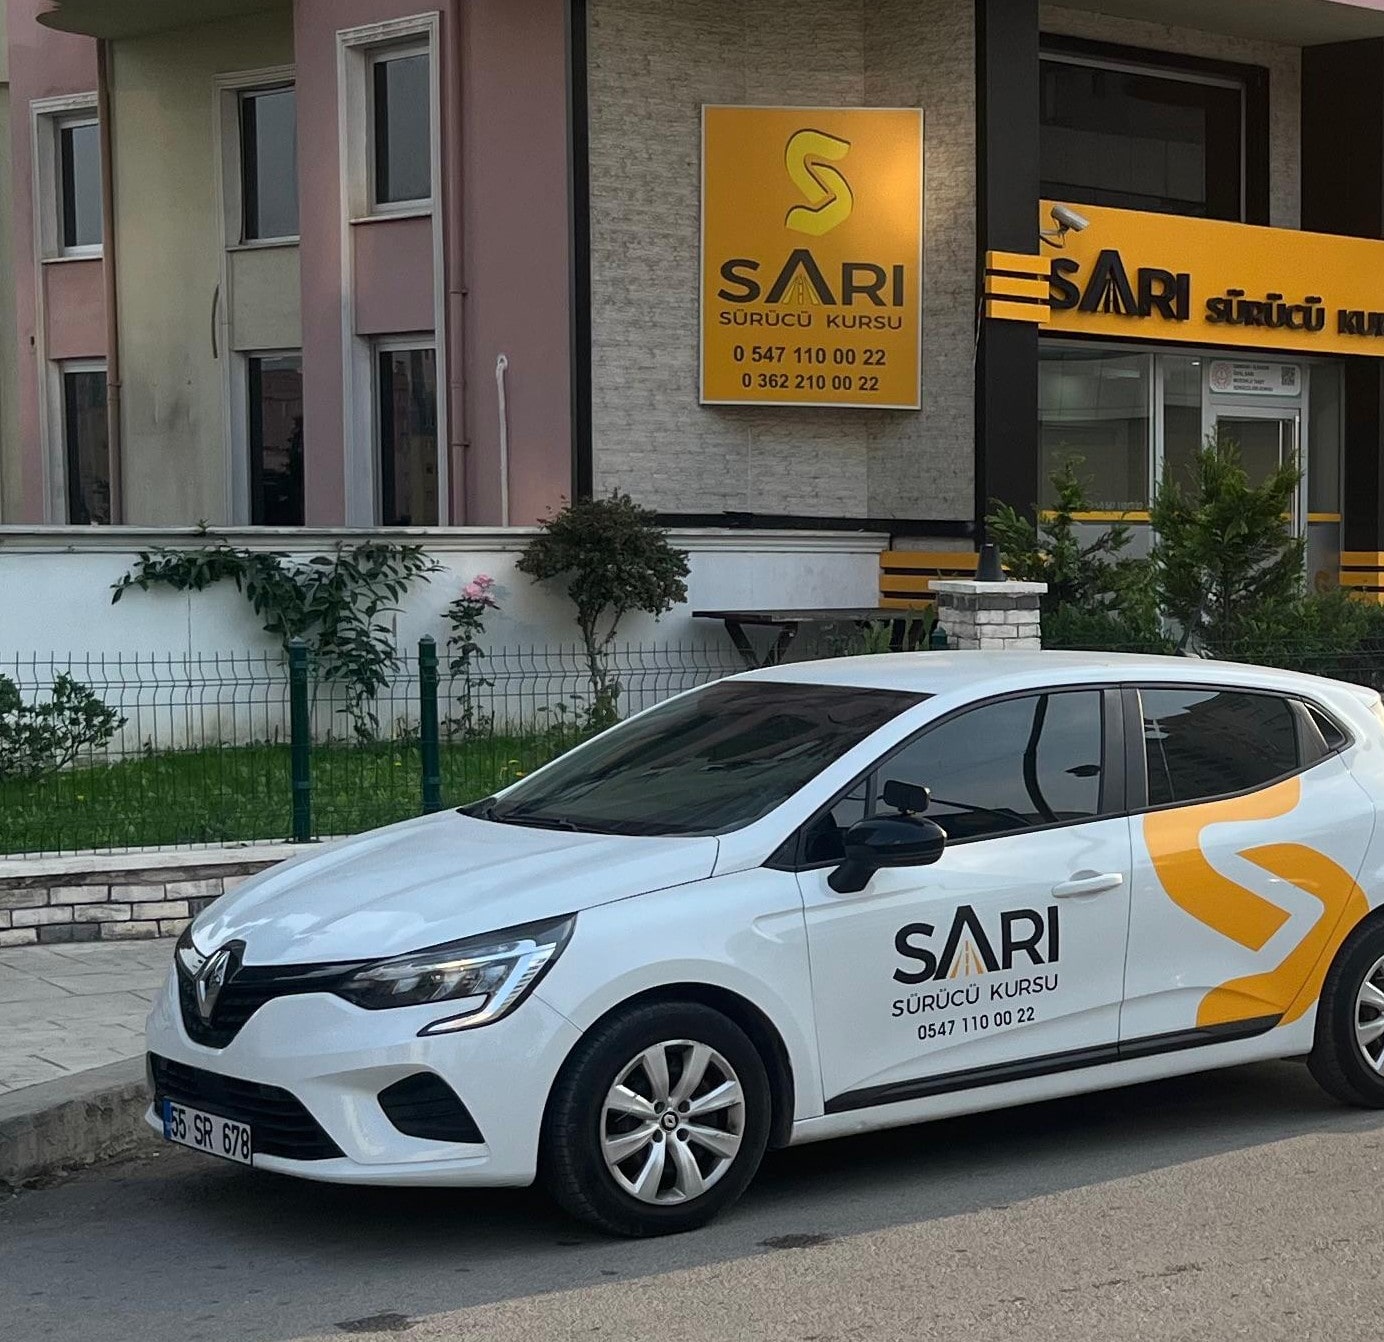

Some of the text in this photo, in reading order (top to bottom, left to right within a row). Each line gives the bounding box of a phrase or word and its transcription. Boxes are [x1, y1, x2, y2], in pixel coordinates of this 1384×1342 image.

[717, 249, 904, 307] SARI
[1050, 250, 1190, 321] SARI
[1206, 289, 1325, 332] SÜRÜCÜ
[719, 309, 902, 330] SÜRÜCÜ KURSU
[733, 345, 886, 366] 0 547 110 00 22
[742, 373, 879, 391] 0 362 210 00 22
[893, 905, 1059, 984] SARI
[892, 974, 1058, 1017] SÜRÜCÜ KURSU
[918, 1006, 1035, 1040] 0547 110 00 22
[171, 1106, 249, 1159] 55 SR 678
